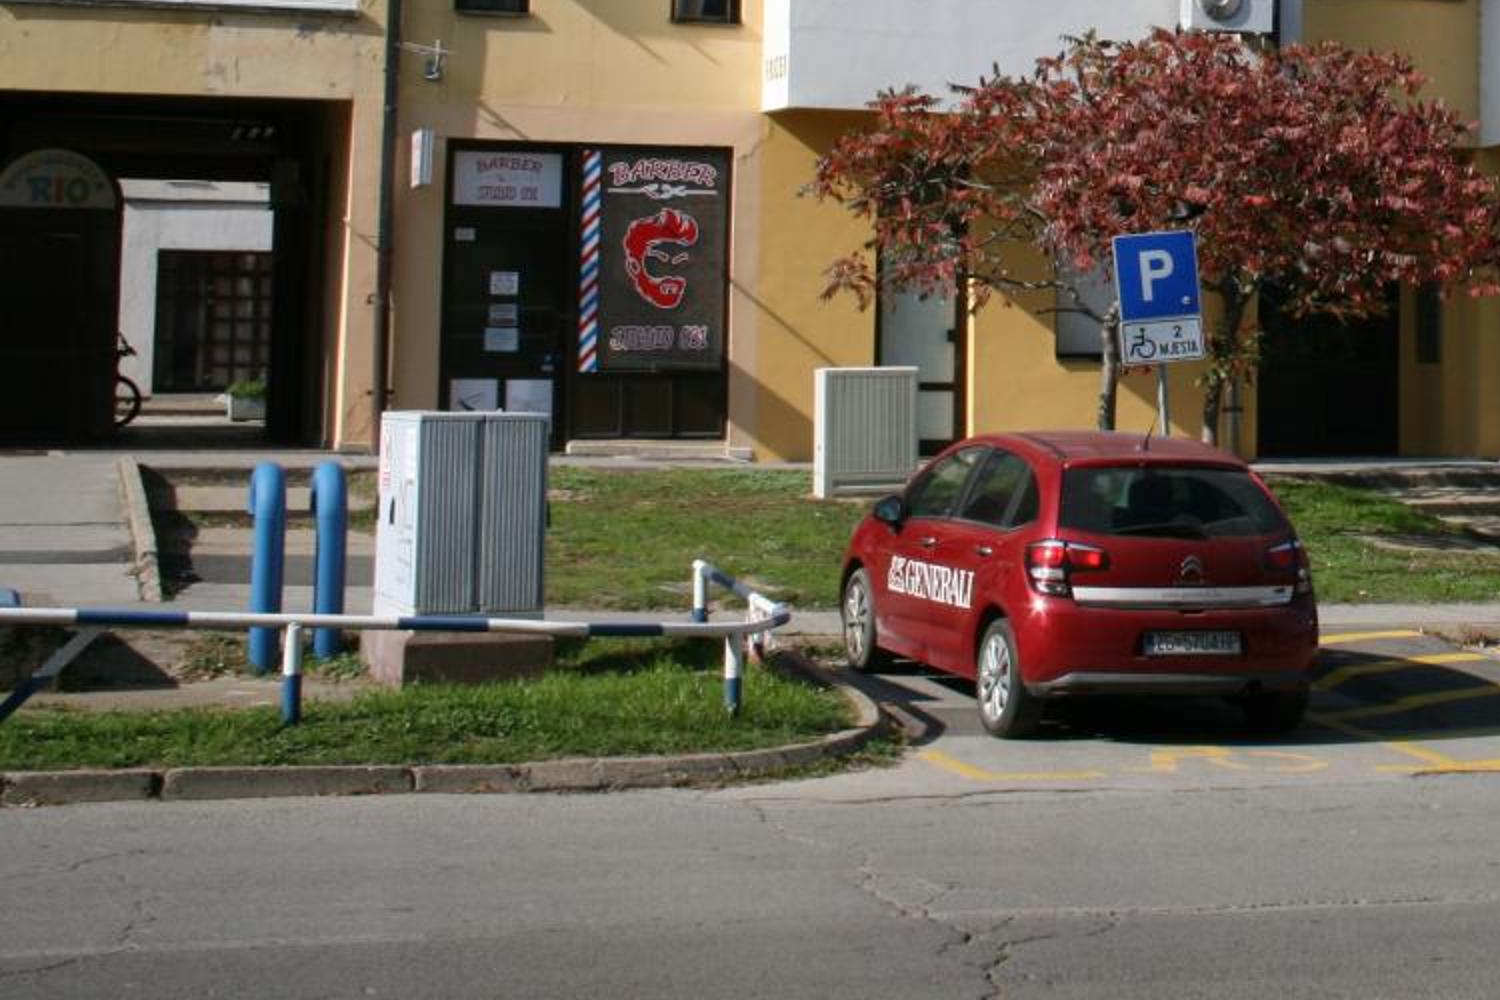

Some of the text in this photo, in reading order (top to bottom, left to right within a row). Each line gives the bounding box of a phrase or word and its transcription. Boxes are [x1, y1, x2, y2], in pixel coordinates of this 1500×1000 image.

[608, 158, 717, 186] BARBER
[27, 177, 90, 203] RIO
[1139, 250, 1174, 302] P
[1173, 325, 1183, 339] 2
[906, 560, 975, 608] GENERALI
